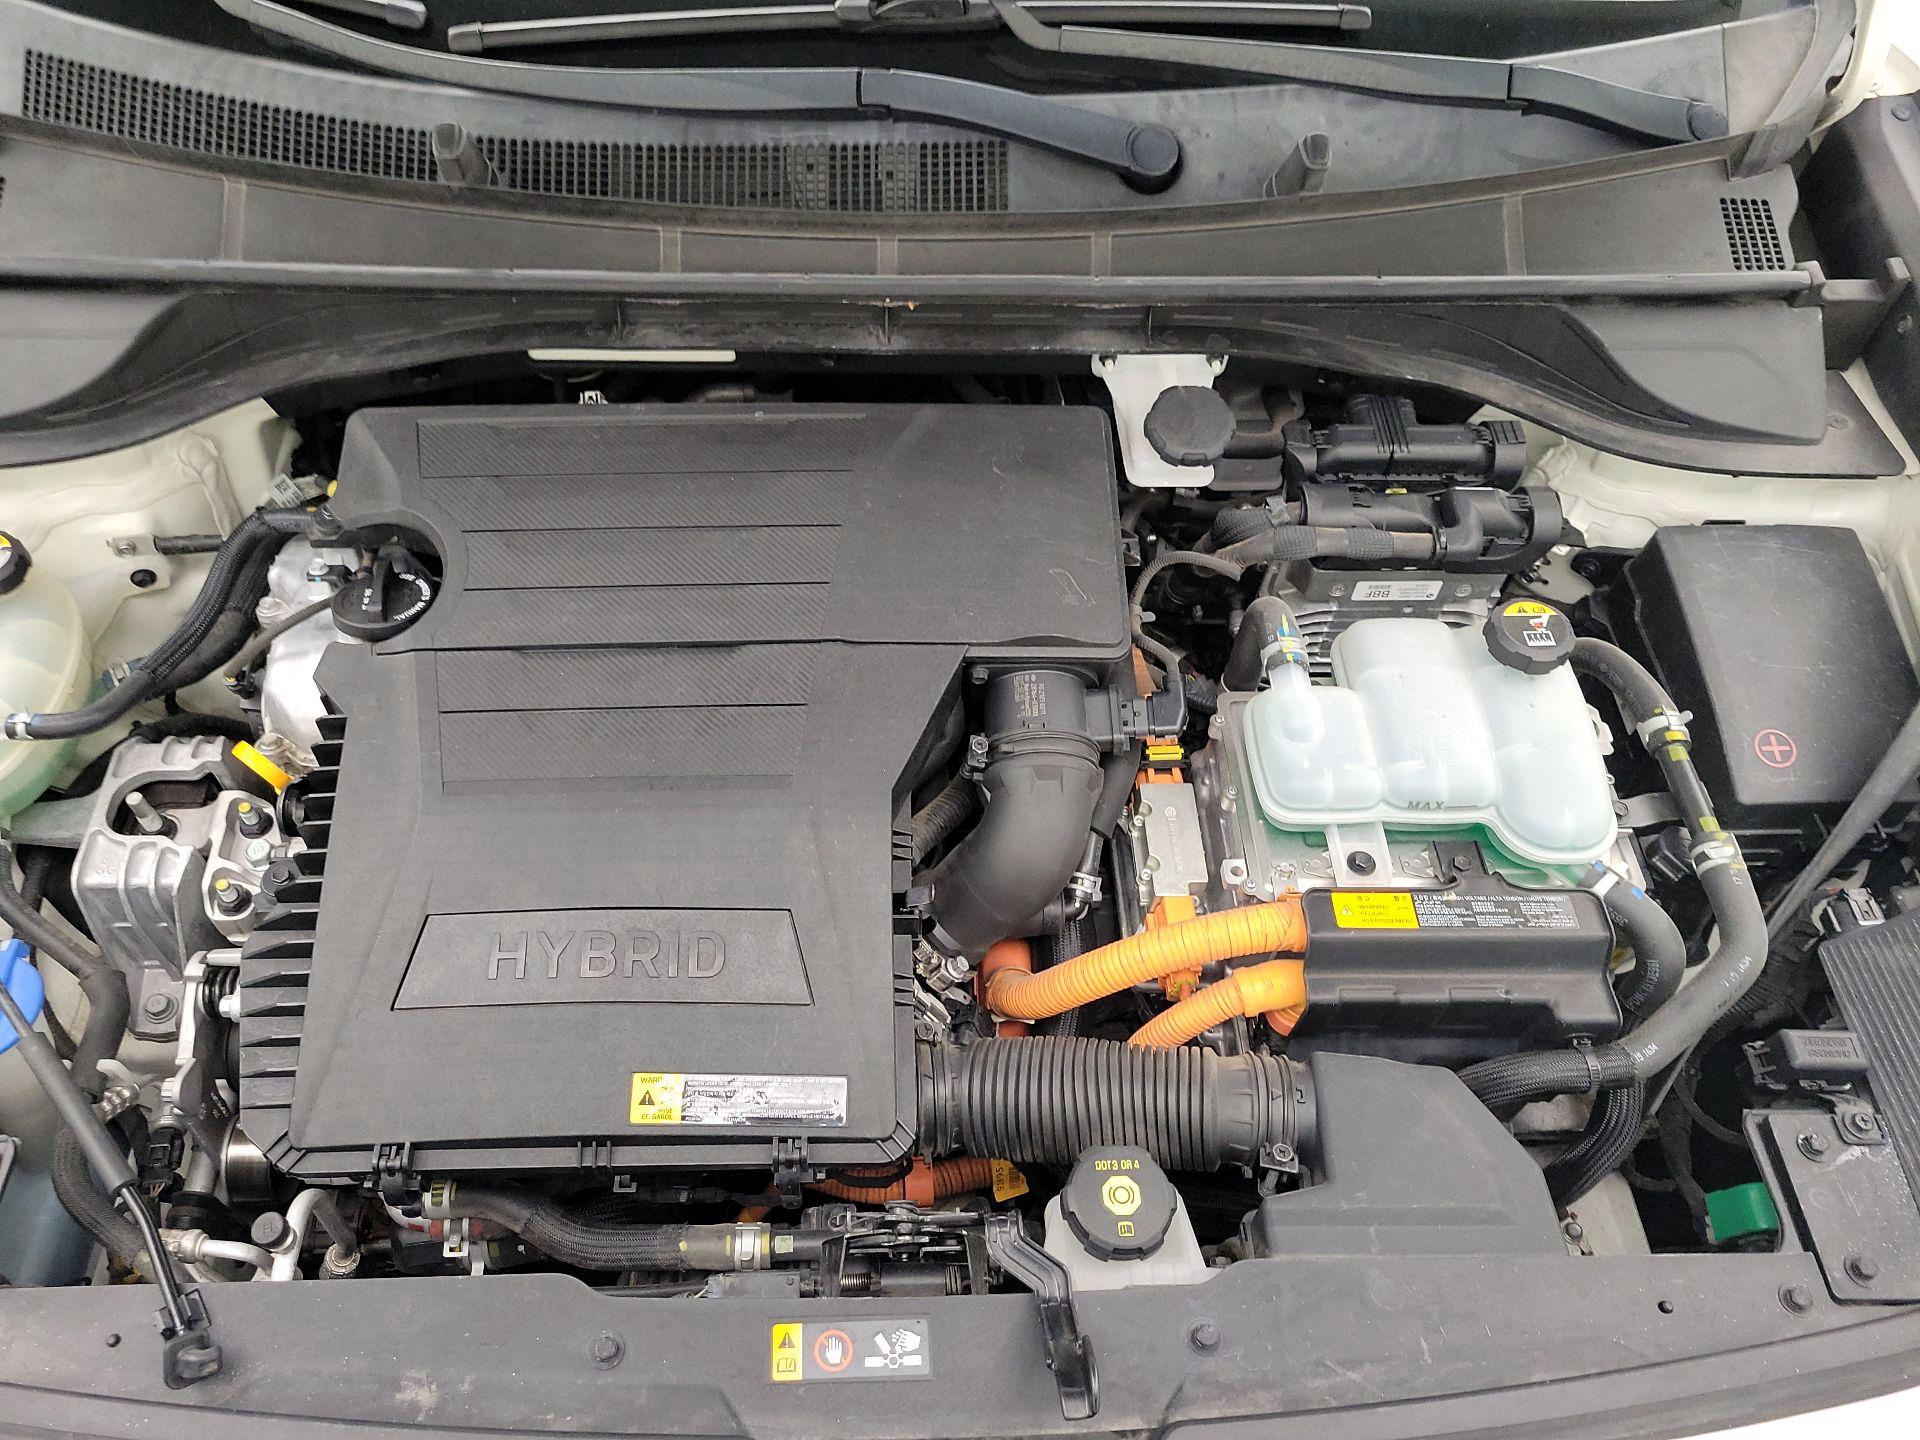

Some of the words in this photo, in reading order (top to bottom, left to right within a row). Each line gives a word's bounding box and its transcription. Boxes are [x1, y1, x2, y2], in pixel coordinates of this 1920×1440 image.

[1364, 590, 1390, 598] BBF
[1407, 800, 1444, 811] MAX
[487, 930, 727, 980] HYBRID
[1120, 1159, 1133, 1170] OR
[1133, 1159, 1140, 1170] 4
